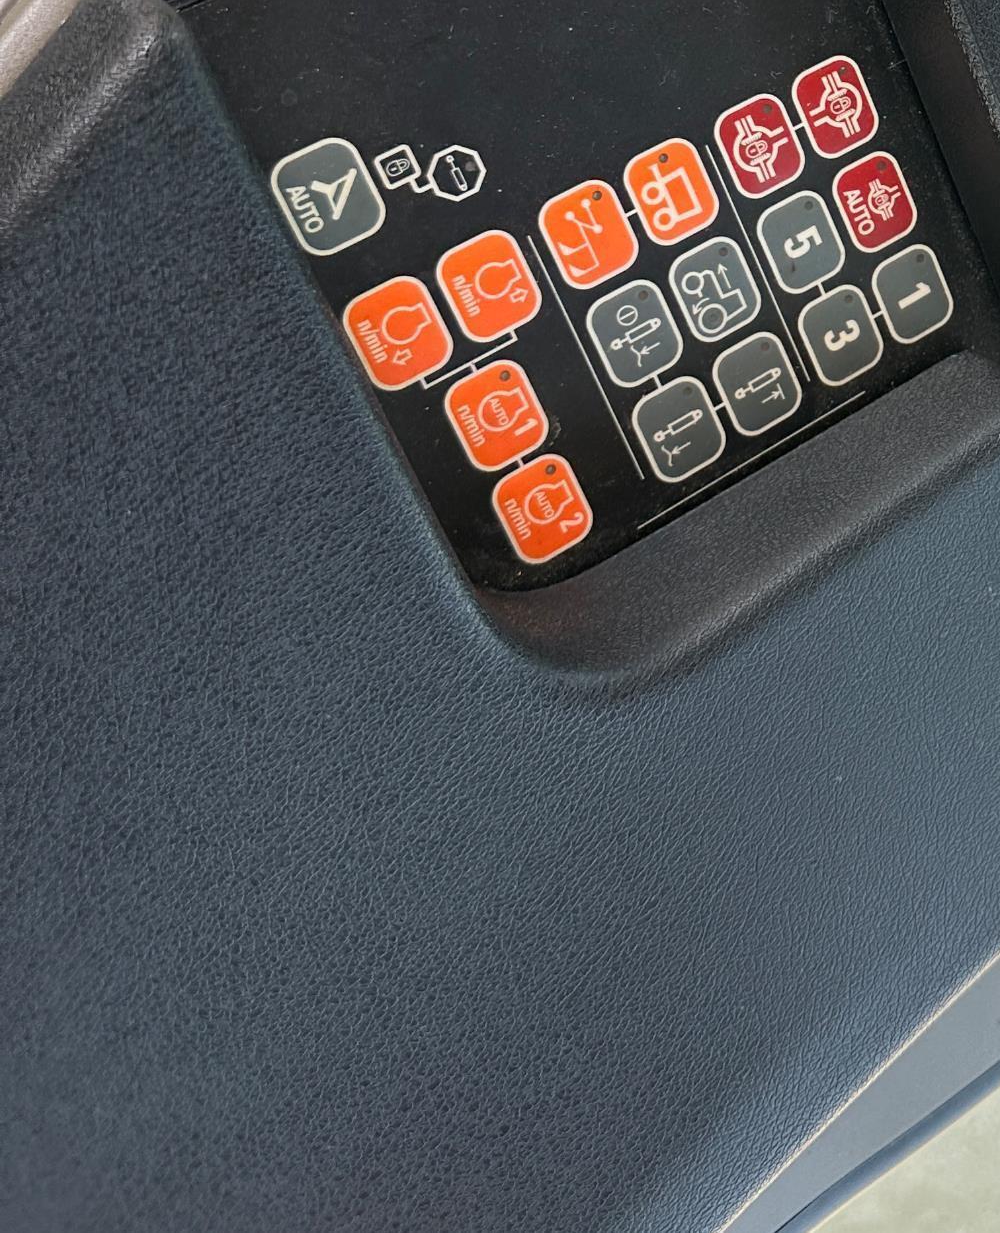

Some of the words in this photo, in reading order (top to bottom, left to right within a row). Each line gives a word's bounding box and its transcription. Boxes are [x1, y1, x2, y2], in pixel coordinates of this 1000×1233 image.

[286, 186, 324, 233] AUTO
[843, 189, 875, 235] AUTO
[784, 225, 823, 259] 5
[453, 275, 480, 317] n/min
[898, 282, 931, 310] 1
[357, 320, 389, 363] n/min
[824, 319, 860, 351] 3
[458, 405, 486, 447] n/min
[489, 397, 510, 427] AUTO
[514, 418, 538, 437] 1
[504, 498, 533, 540] n/min
[534, 491, 555, 519] AUTO
[559, 512, 585, 534] 2
